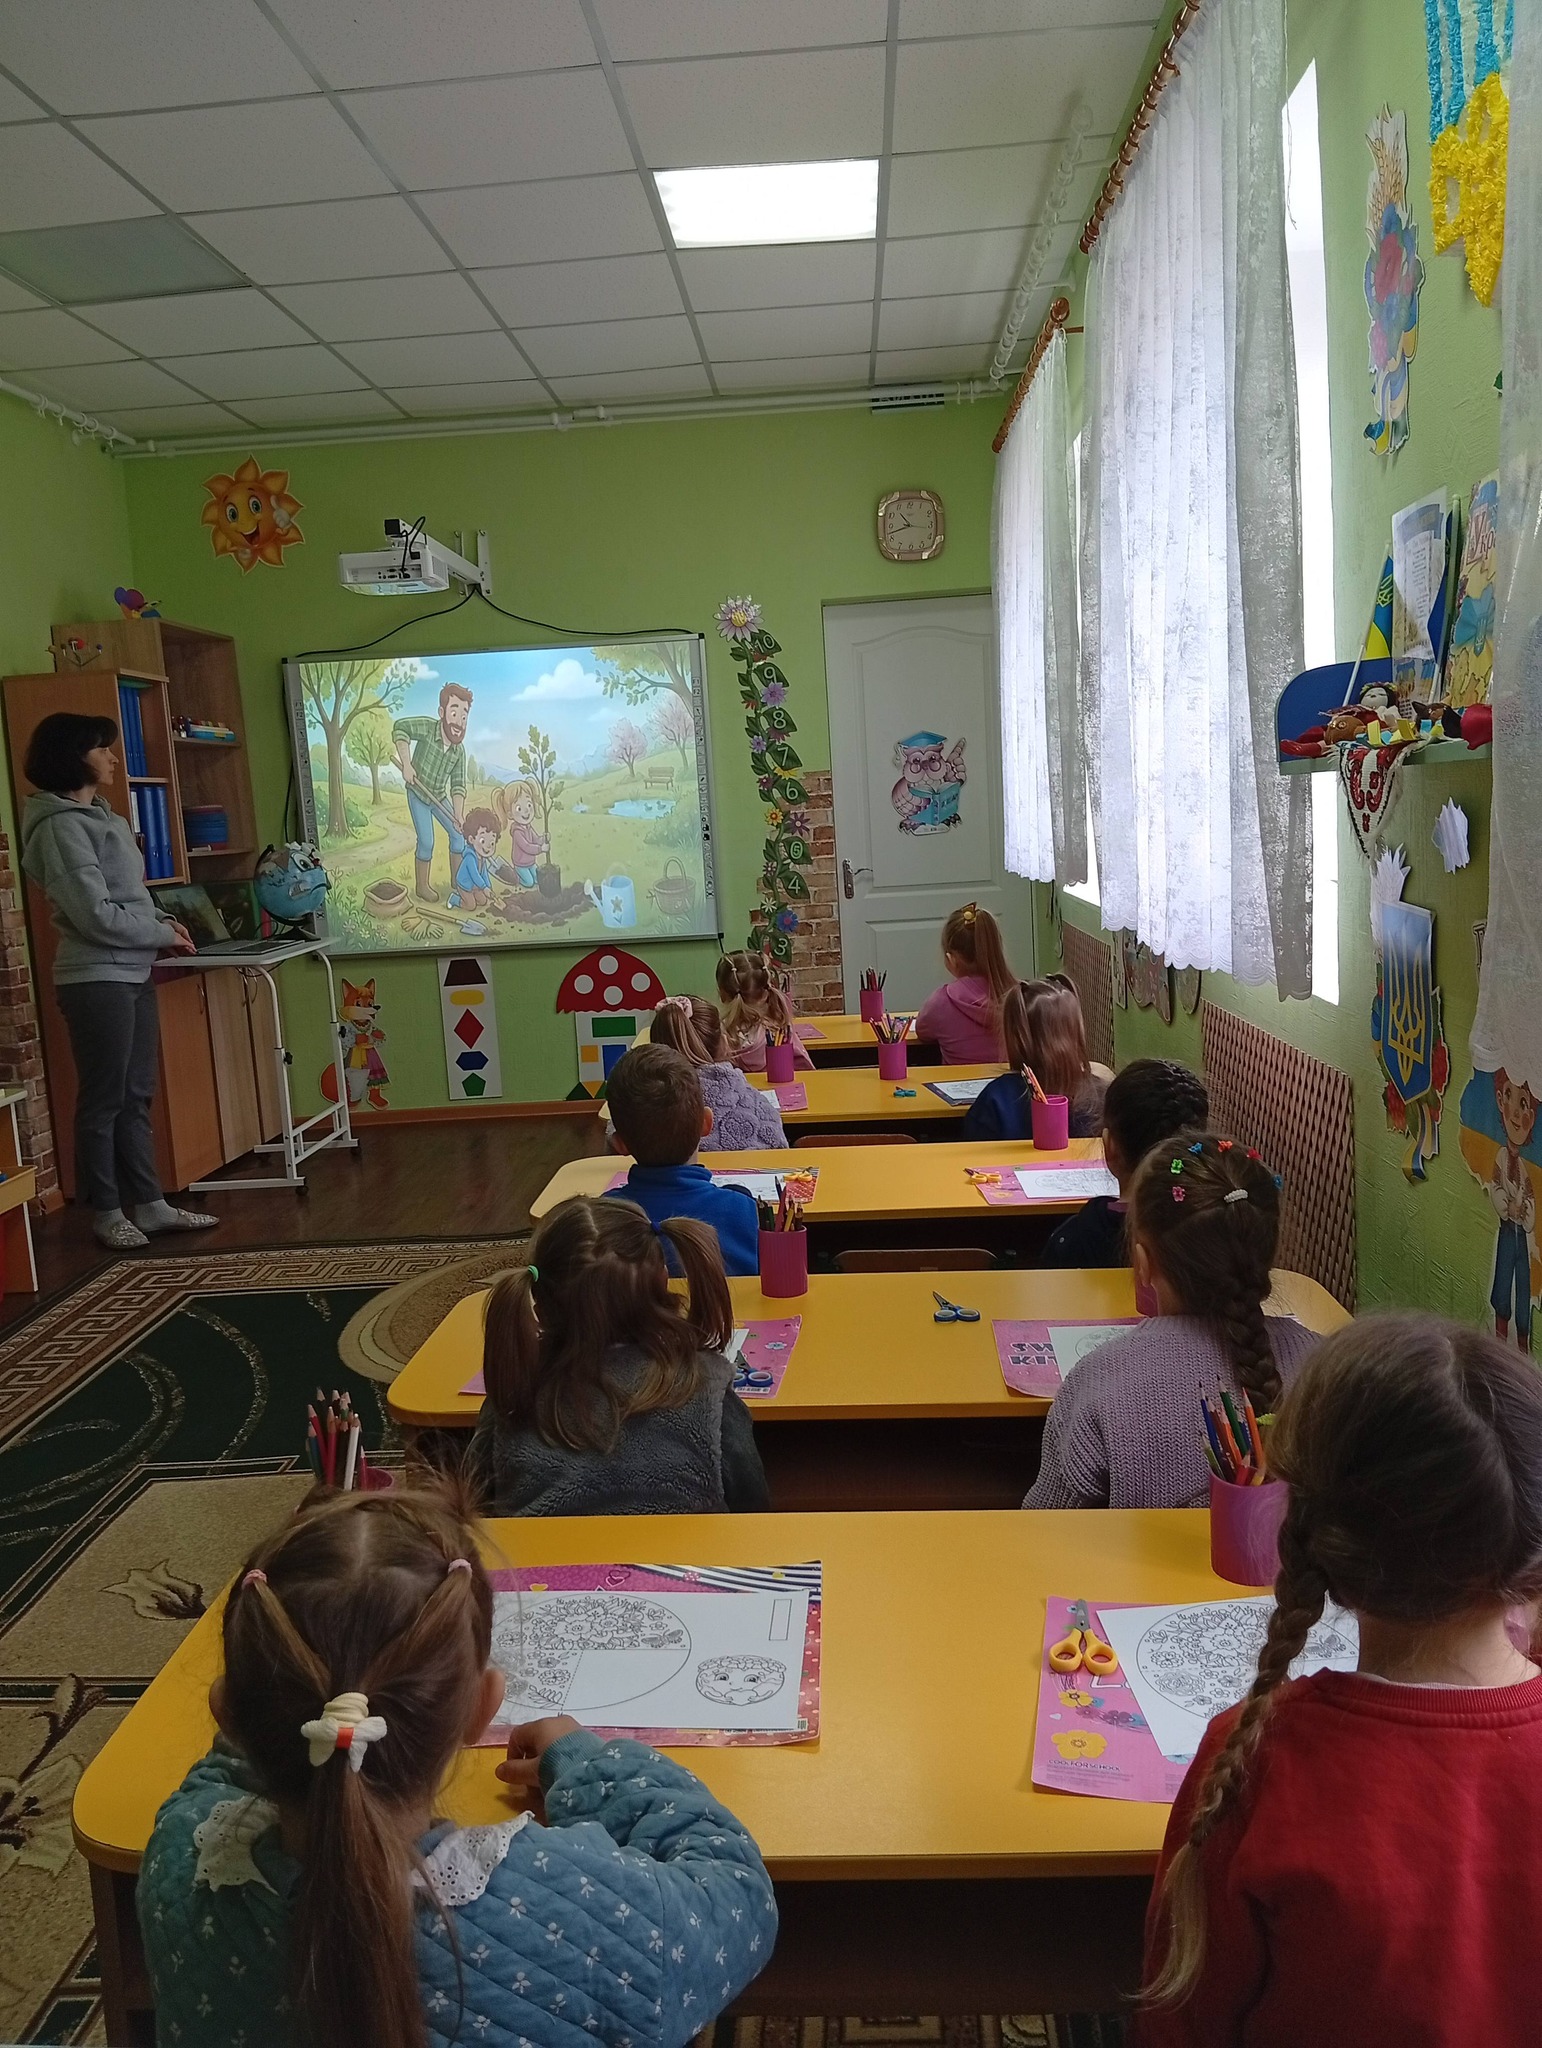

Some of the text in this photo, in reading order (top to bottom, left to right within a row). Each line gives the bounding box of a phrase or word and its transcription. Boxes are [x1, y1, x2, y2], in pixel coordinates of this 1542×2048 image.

[754, 634, 775, 654] 10
[763, 666, 777, 684] 9
[773, 710, 787, 729] 8
[777, 746, 789, 766] 7
[786, 782, 799, 800] 6
[788, 875, 801, 894] 4
[774, 938, 788, 956] 3
[1070, 1761, 1089, 1769] FOR
